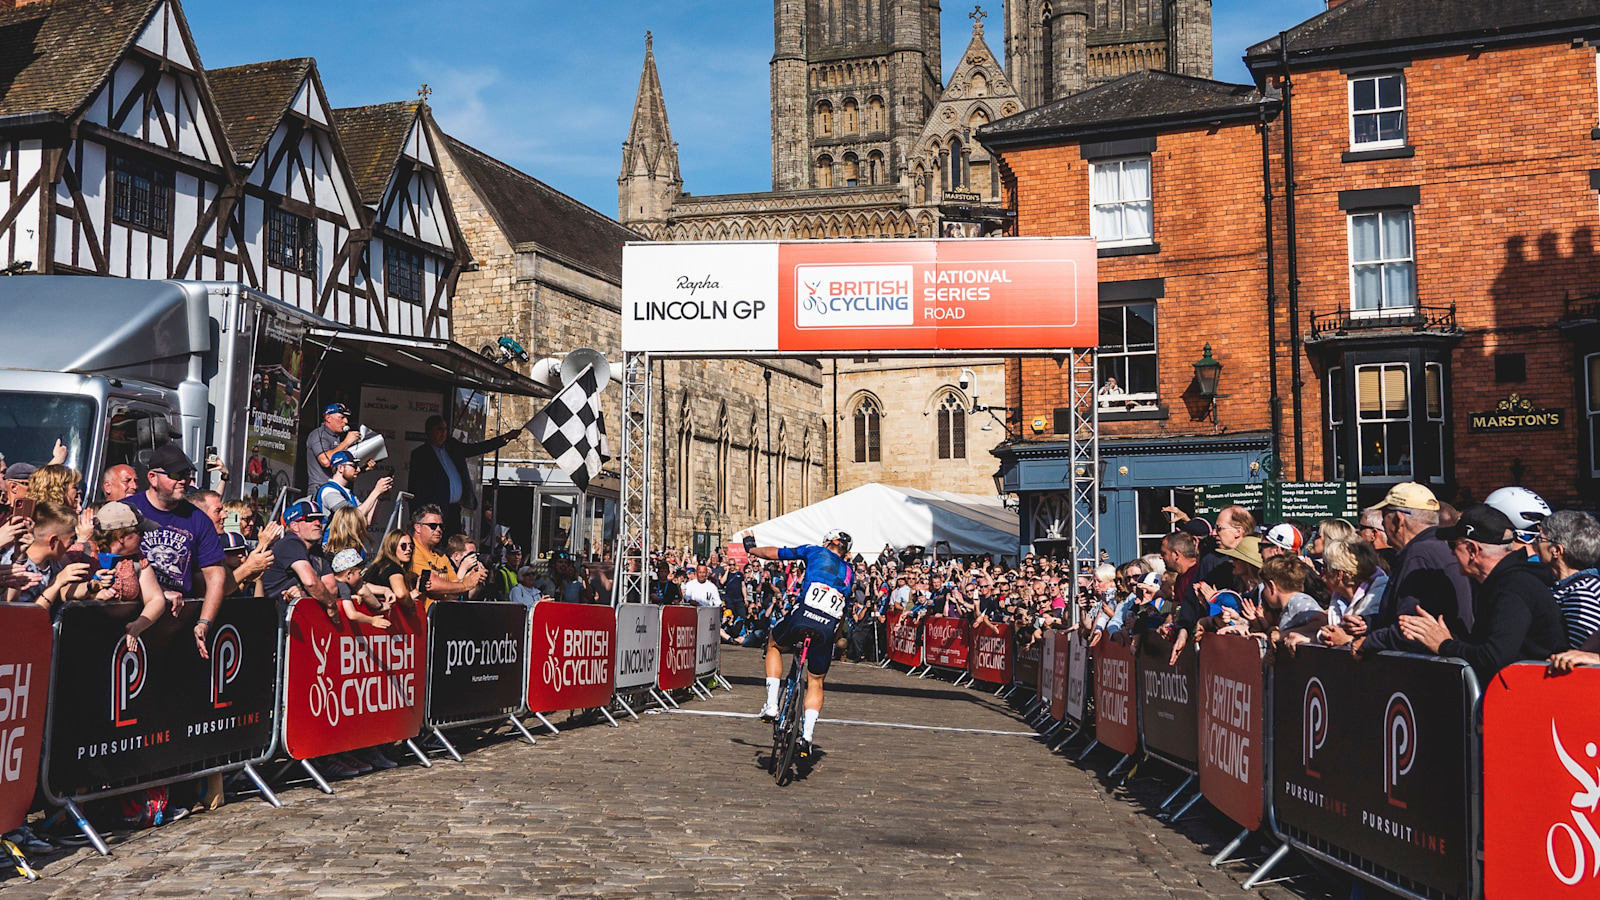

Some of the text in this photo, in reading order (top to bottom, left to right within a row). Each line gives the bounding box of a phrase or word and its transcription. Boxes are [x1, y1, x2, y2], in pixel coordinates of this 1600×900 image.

[945, 193, 980, 201] MARSTON'S
[676, 274, 720, 296] Rapha
[830, 280, 908, 296] BRITISH
[924, 270, 1012, 284] NATIONAL
[830, 296, 908, 312] CYCLING
[924, 287, 990, 301] SERIES
[634, 300, 766, 320] LINCOLN GP
[924, 307, 966, 320] ROAD
[252, 406, 294, 426] From grassroots
[1473, 413, 1560, 428] MARSTON'S
[260, 425, 272, 436] gold
[812, 588, 843, 611] 97 97
[803, 610, 830, 624] TRINITY
[563, 629, 609, 657] BRITISH
[676, 626, 695, 647] BRITISH
[980, 636, 1006, 654] BRITISH
[340, 634, 415, 676] BRITISH
[445, 632, 518, 675] pro-noctis
[676, 648, 695, 670] CYCLING
[979, 652, 1005, 670] CYCLING
[563, 658, 608, 686] CYCLING
[1102, 658, 1128, 692] BRITISH
[341, 672, 415, 716] CYCLING
[1144, 666, 1188, 704] pro-noctis
[1101, 690, 1128, 726] CYCLING
[1212, 674, 1251, 732] BRITISH
[188, 712, 260, 737] PURSUITLINE
[78, 730, 170, 760] PURSUITLINE
[1209, 723, 1250, 784] CYCLING
[1286, 781, 1347, 817] PURSUITLINE
[1362, 810, 1446, 855] PURSUITLINE
